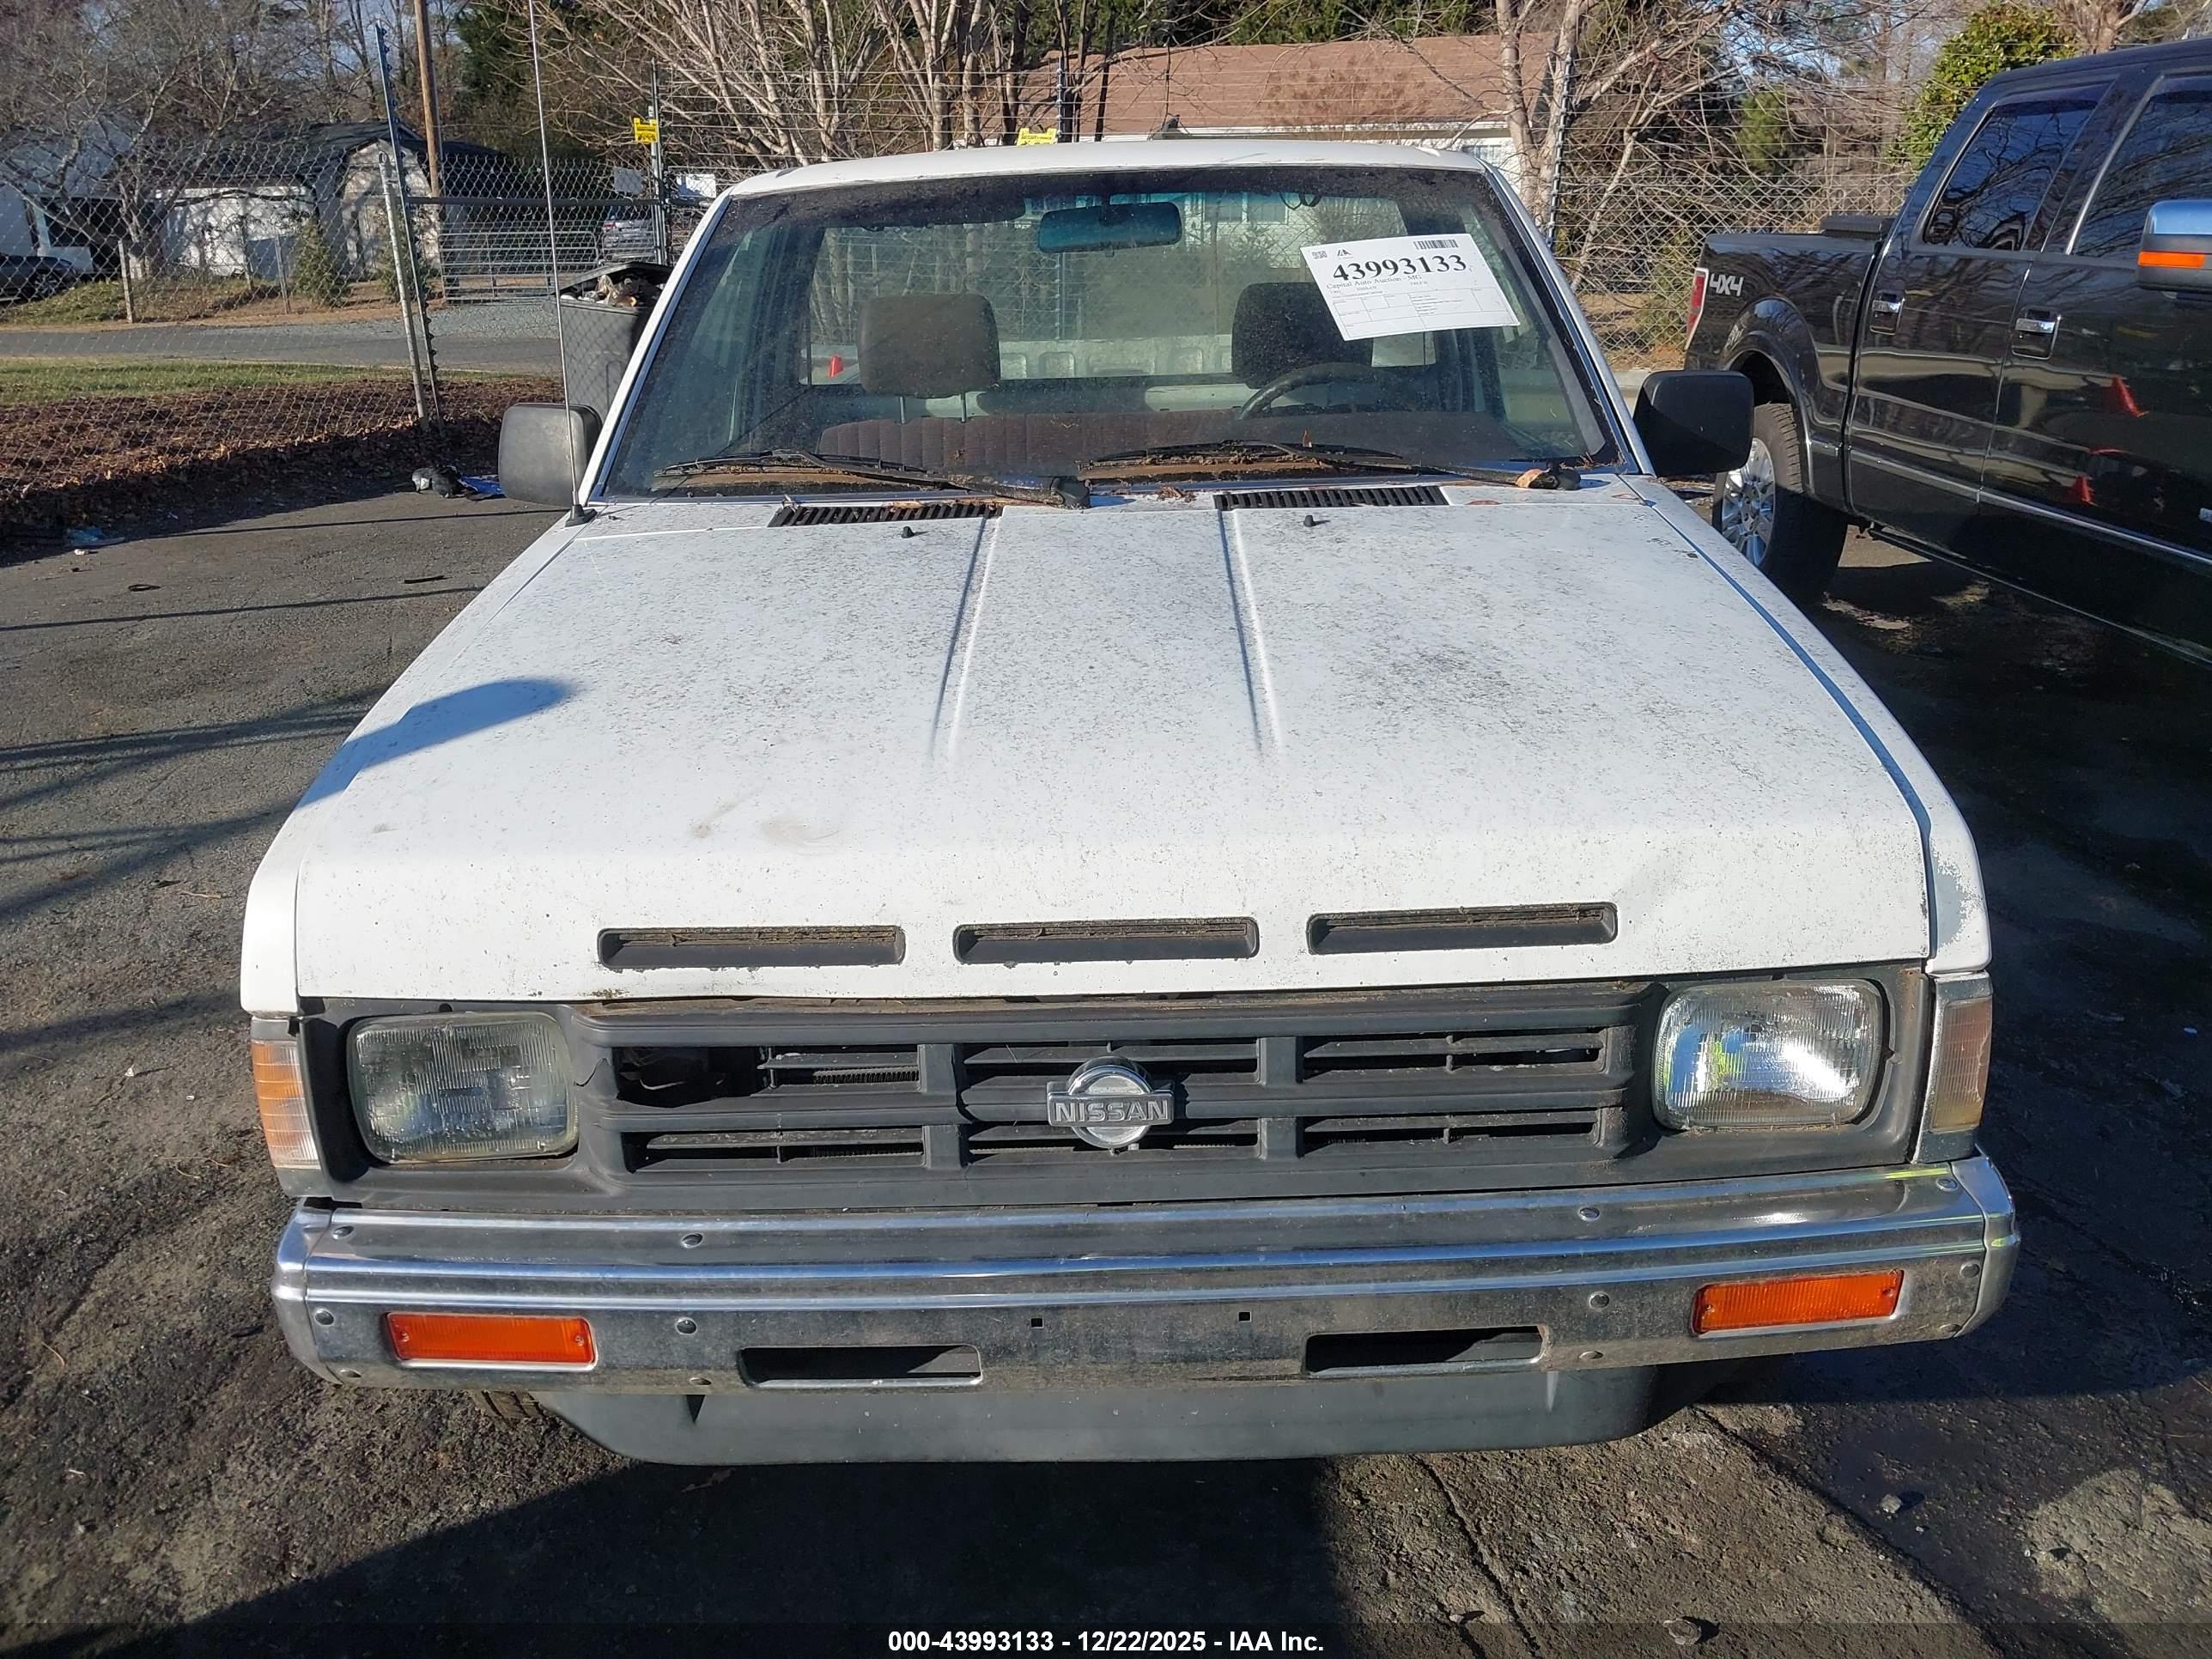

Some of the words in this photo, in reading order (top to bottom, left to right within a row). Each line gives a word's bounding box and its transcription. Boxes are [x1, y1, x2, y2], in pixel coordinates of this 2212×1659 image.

[1333, 255, 1467, 281] 43993133
[1327, 282, 1352, 290] Capital
[1054, 1099, 1169, 1122] NISSAN
